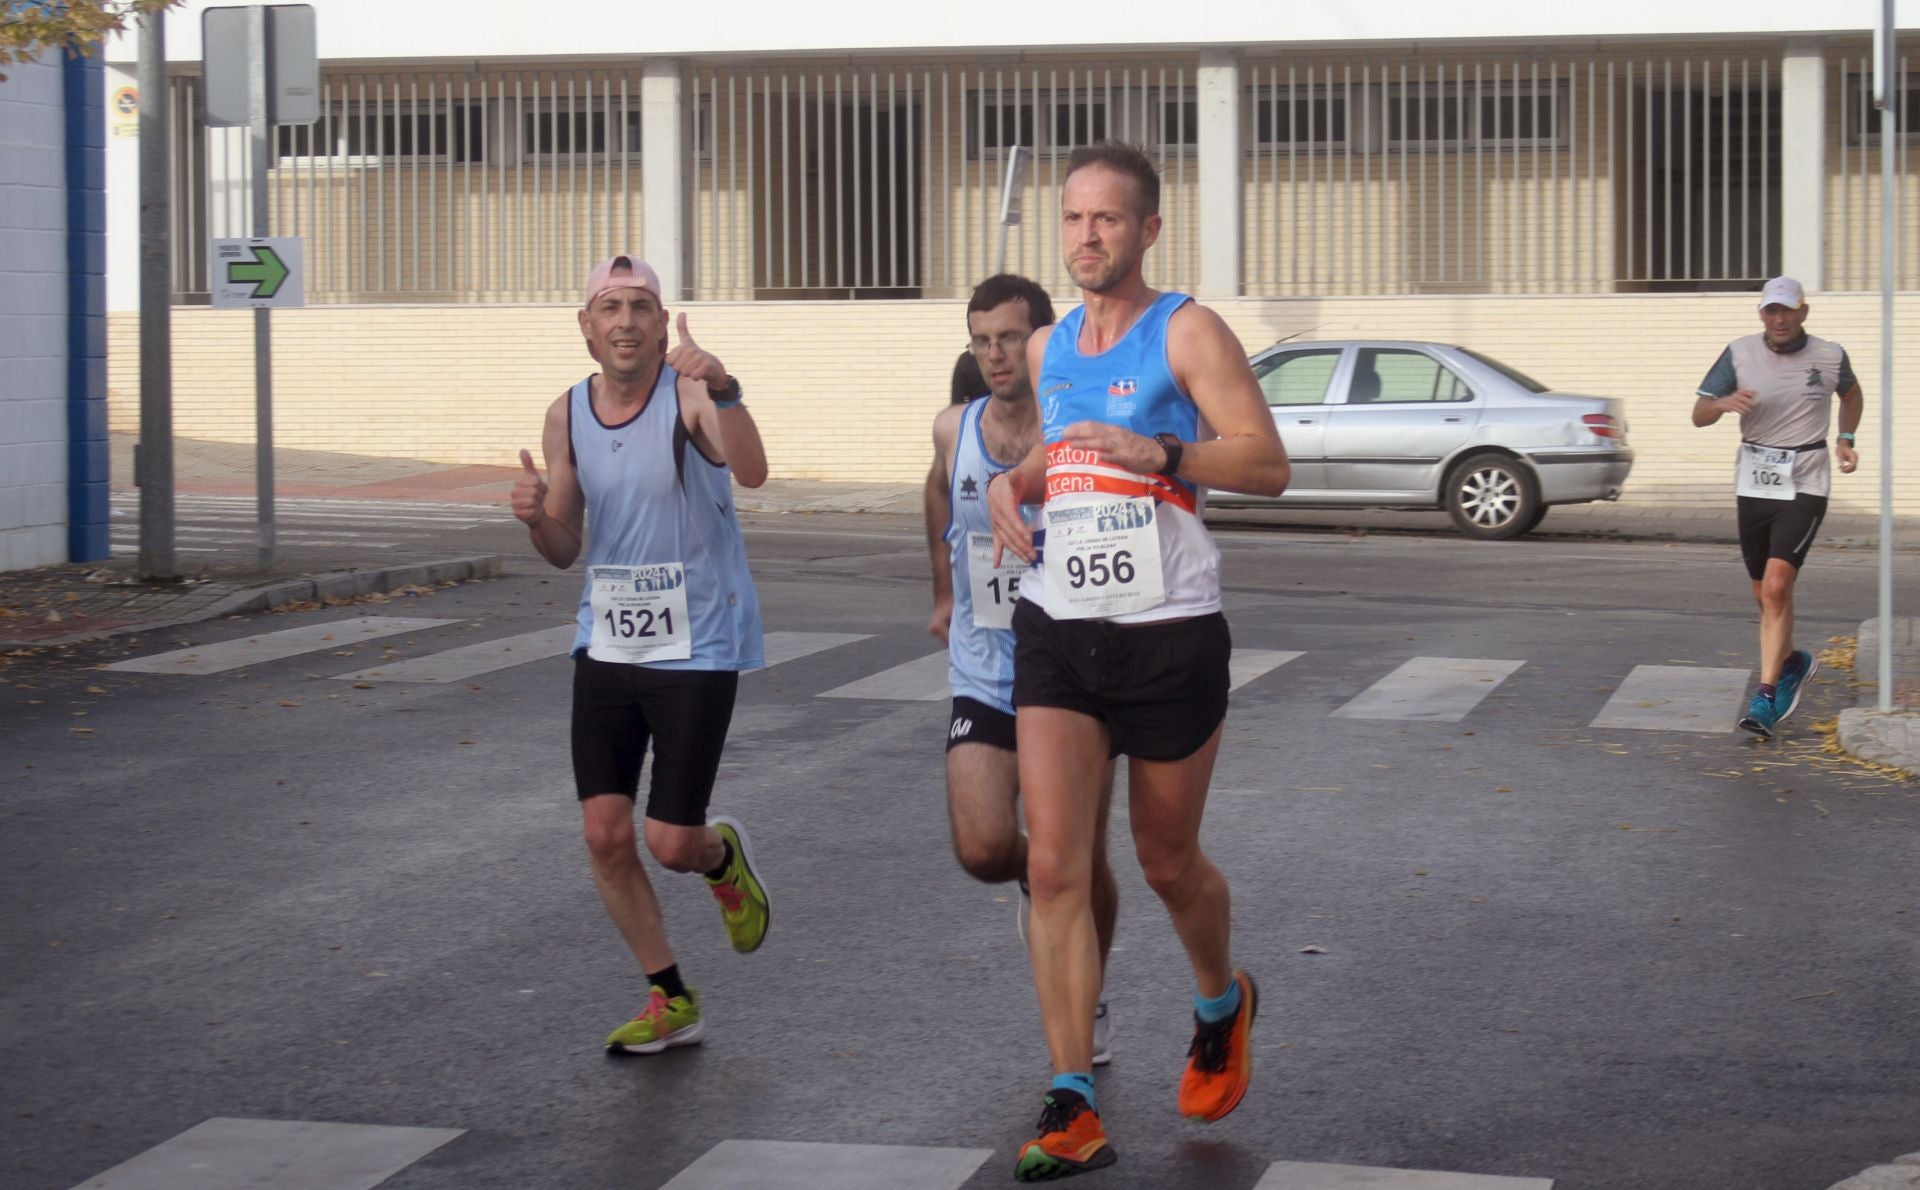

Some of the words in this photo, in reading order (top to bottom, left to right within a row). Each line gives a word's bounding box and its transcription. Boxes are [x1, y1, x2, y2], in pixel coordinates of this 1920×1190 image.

[1752, 470, 1782, 485] 102
[1095, 503, 1127, 518] 2024
[632, 567, 661, 580] 2024
[1067, 550, 1135, 589] 956
[605, 608, 673, 638] 1521
